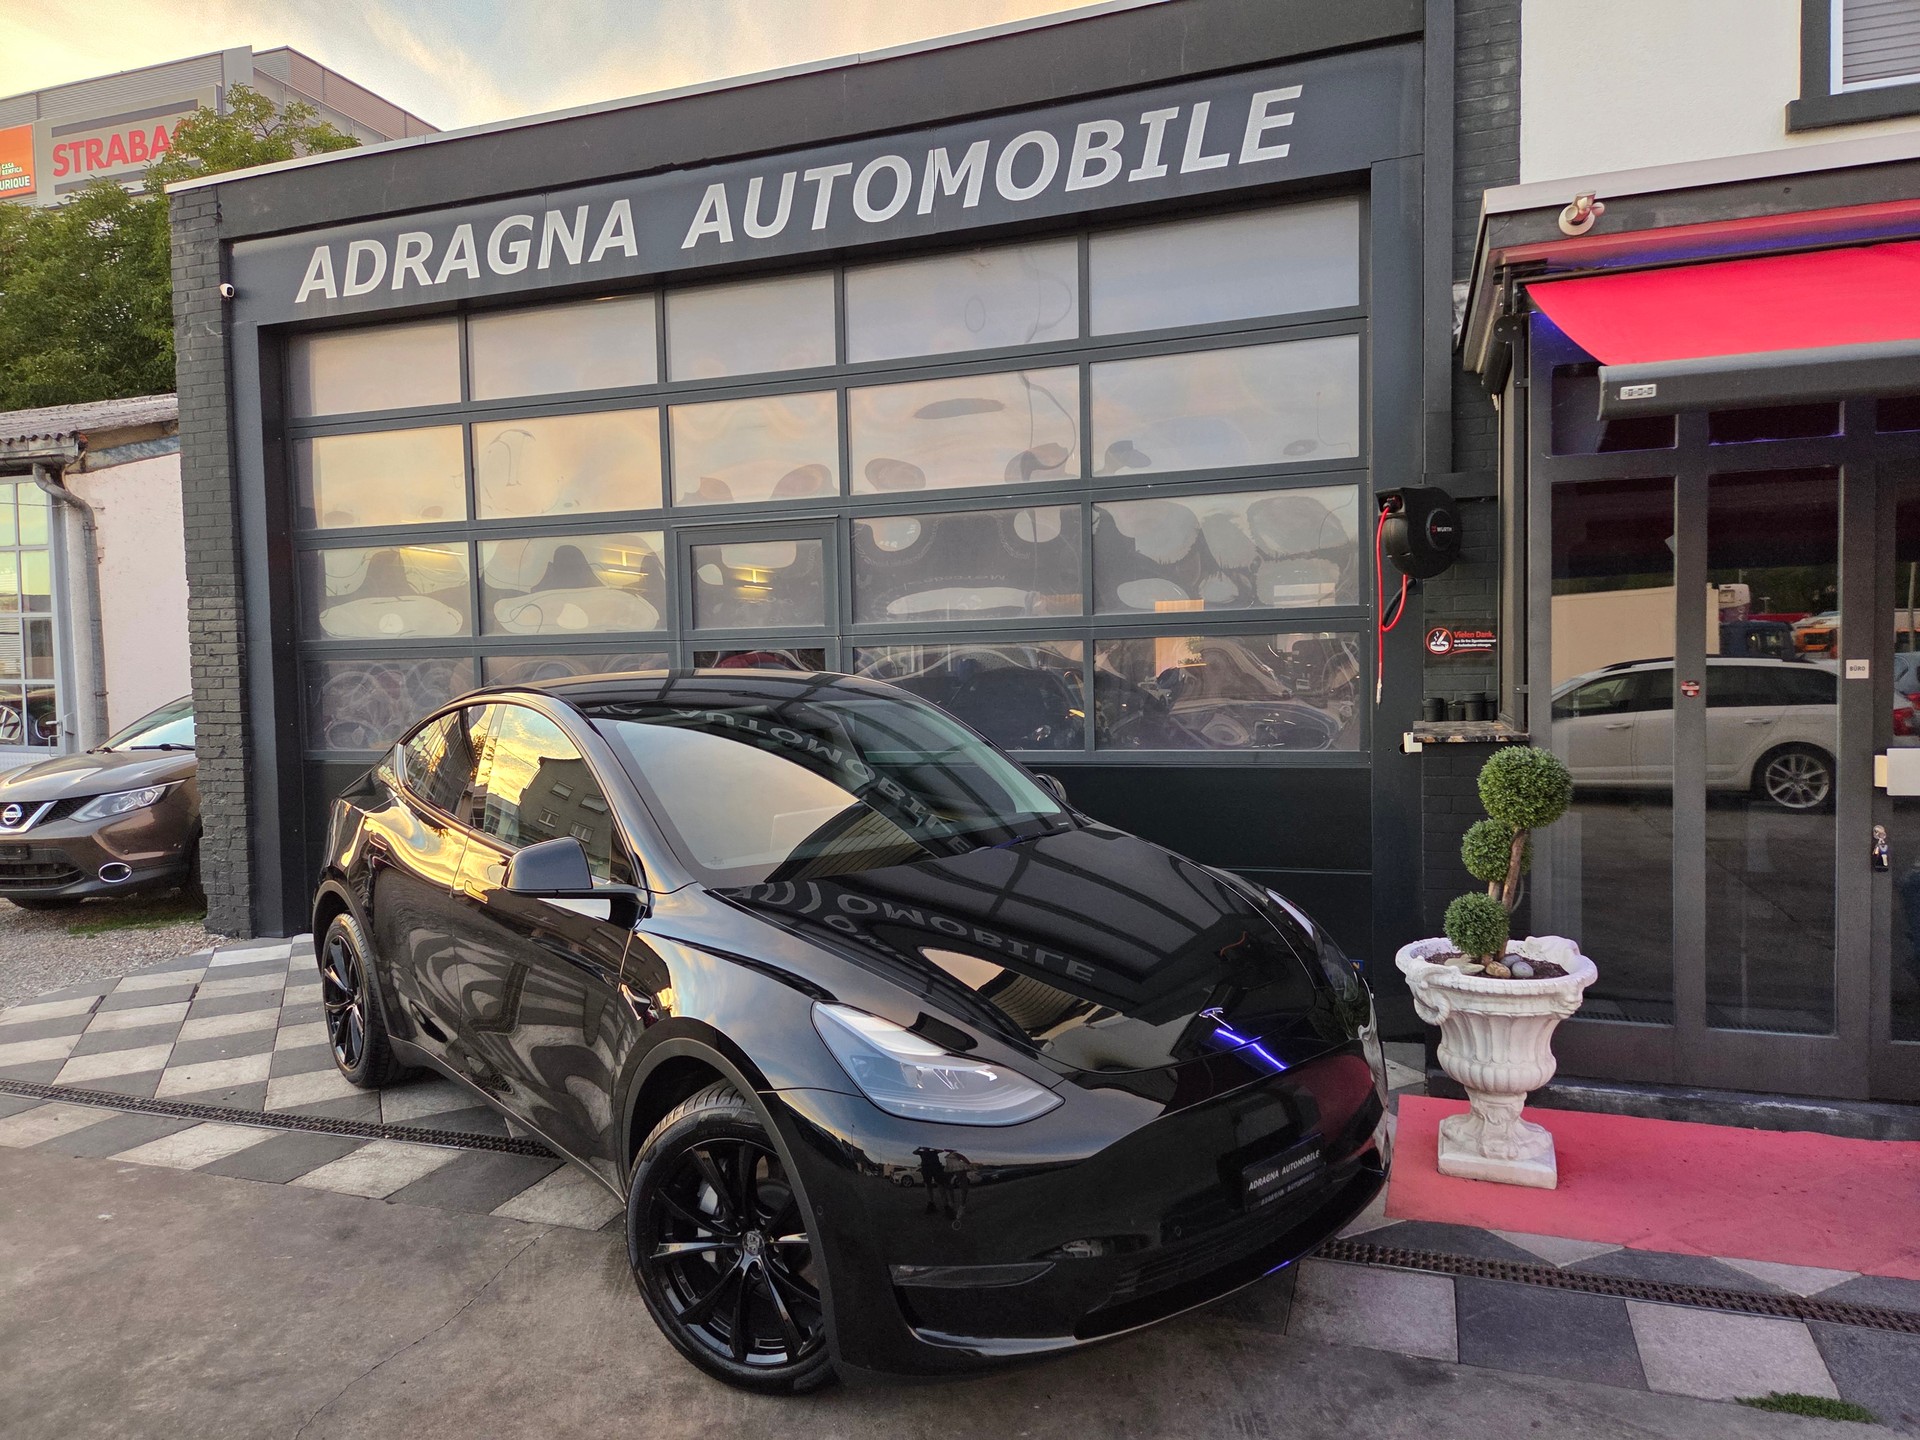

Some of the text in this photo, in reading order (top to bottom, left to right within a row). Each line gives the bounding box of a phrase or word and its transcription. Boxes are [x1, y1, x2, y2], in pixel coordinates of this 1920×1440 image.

[295, 84, 1303, 303] ADRAGNA AUTOMOBILE
[1248, 1170, 1280, 1191] ADRAGNA
[1282, 1149, 1321, 1175] AUTOMOBILE
